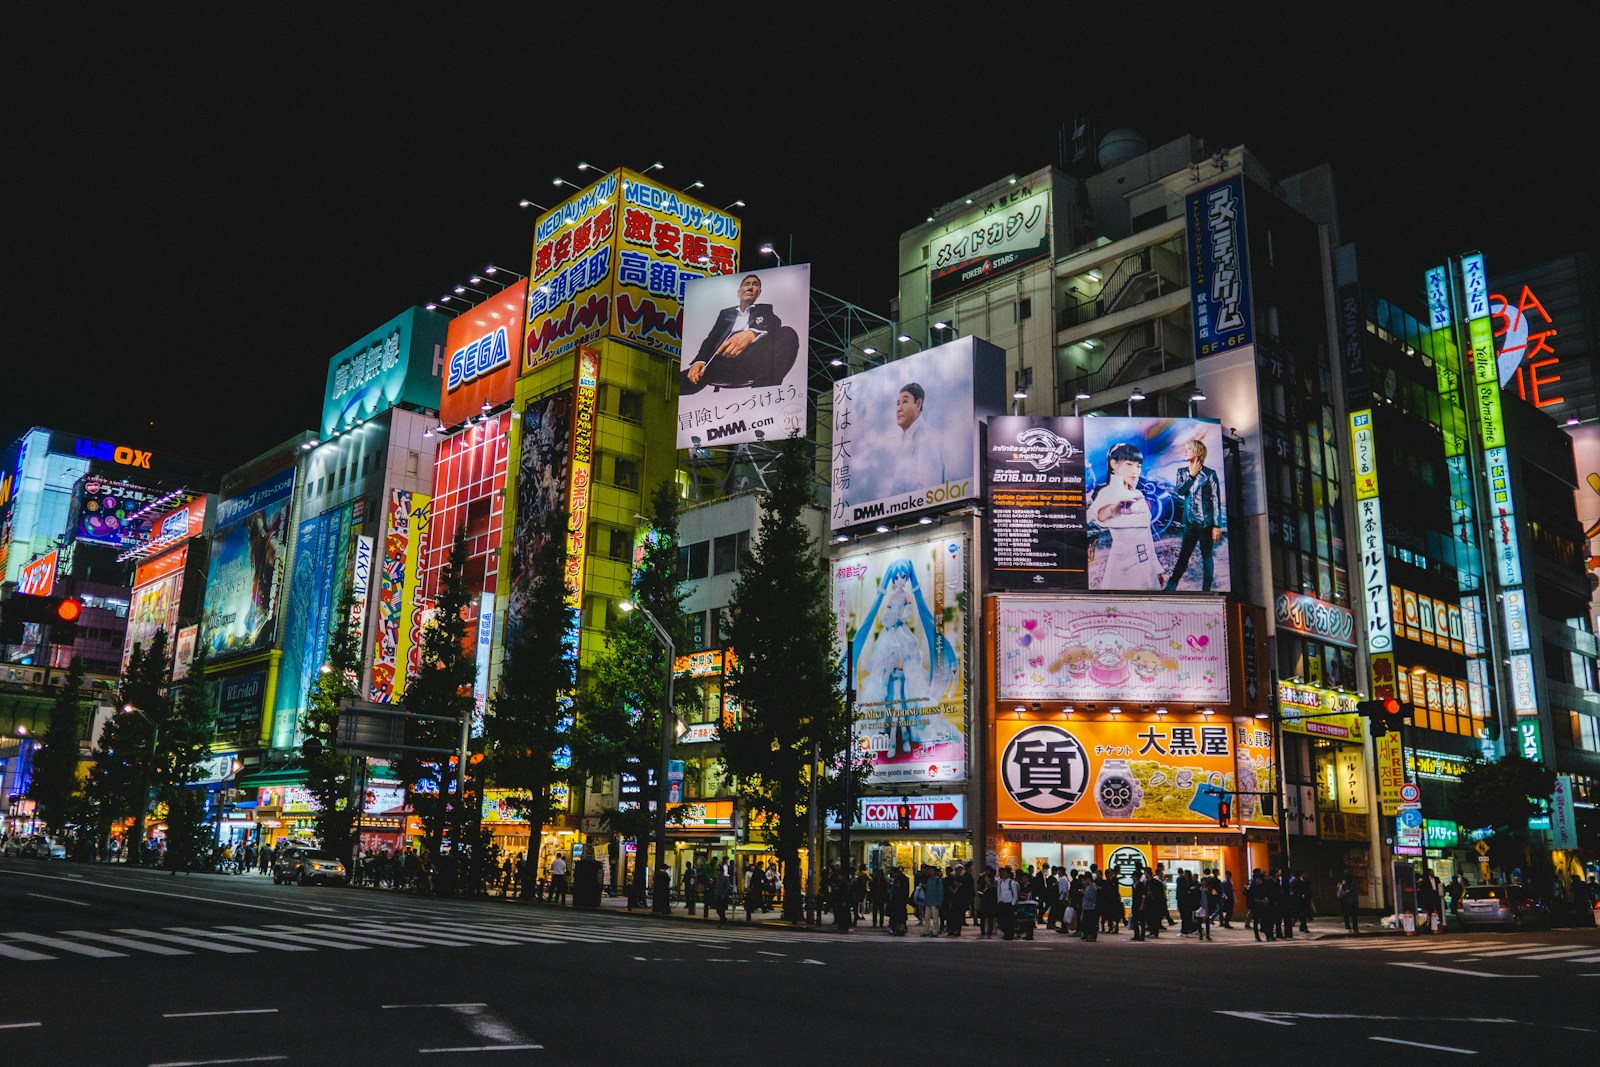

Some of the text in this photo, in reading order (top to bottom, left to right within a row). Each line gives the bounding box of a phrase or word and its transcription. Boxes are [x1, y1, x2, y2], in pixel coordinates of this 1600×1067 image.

[534, 203, 616, 280] 激安販売
[622, 206, 737, 275] 激安販売
[937, 205, 1041, 267] メイドカジノ
[528, 244, 611, 322] 高額買取
[962, 266, 982, 281] POKER
[447, 326, 511, 392] SEGA
[1476, 347, 1488, 379] Yellow
[580, 388, 594, 397] DVD
[677, 384, 806, 431] 冒険しつづけよう。
[580, 412, 590, 420] CD
[706, 415, 775, 442] DMM.com
[1355, 414, 1368, 426] 3F
[1481, 387, 1495, 443] Submarine
[833, 379, 853, 527] 次は太陽か。
[1056, 444, 1064, 455] 4
[1358, 432, 1370, 473] りらくる
[1490, 449, 1501, 457] 5F
[926, 480, 970, 506] solar
[993, 474, 1047, 482] 2018.10.10
[1062, 475, 1082, 483] sale
[853, 496, 925, 521] DMM.make
[356, 539, 371, 585] AKKY
[836, 566, 867, 579] 初音ミク
[480, 613, 492, 645] SEGA
[1276, 594, 1354, 639] メイドカジノ
[1508, 593, 1524, 648] amiami
[1281, 687, 1319, 707] 全身もみほぐし
[1515, 657, 1531, 706] あみあみ
[941, 704, 958, 713] Ver.
[1095, 727, 1229, 757] チケット 大黒屋
[1013, 738, 1082, 802] 質
[1391, 748, 1402, 787] FREE
[1347, 763, 1358, 805] ルノアール
[1404, 789, 1415, 797] 40
[914, 804, 934, 819] ZIN
[1406, 813, 1415, 825] P
[1428, 826, 1457, 840] リバティー
